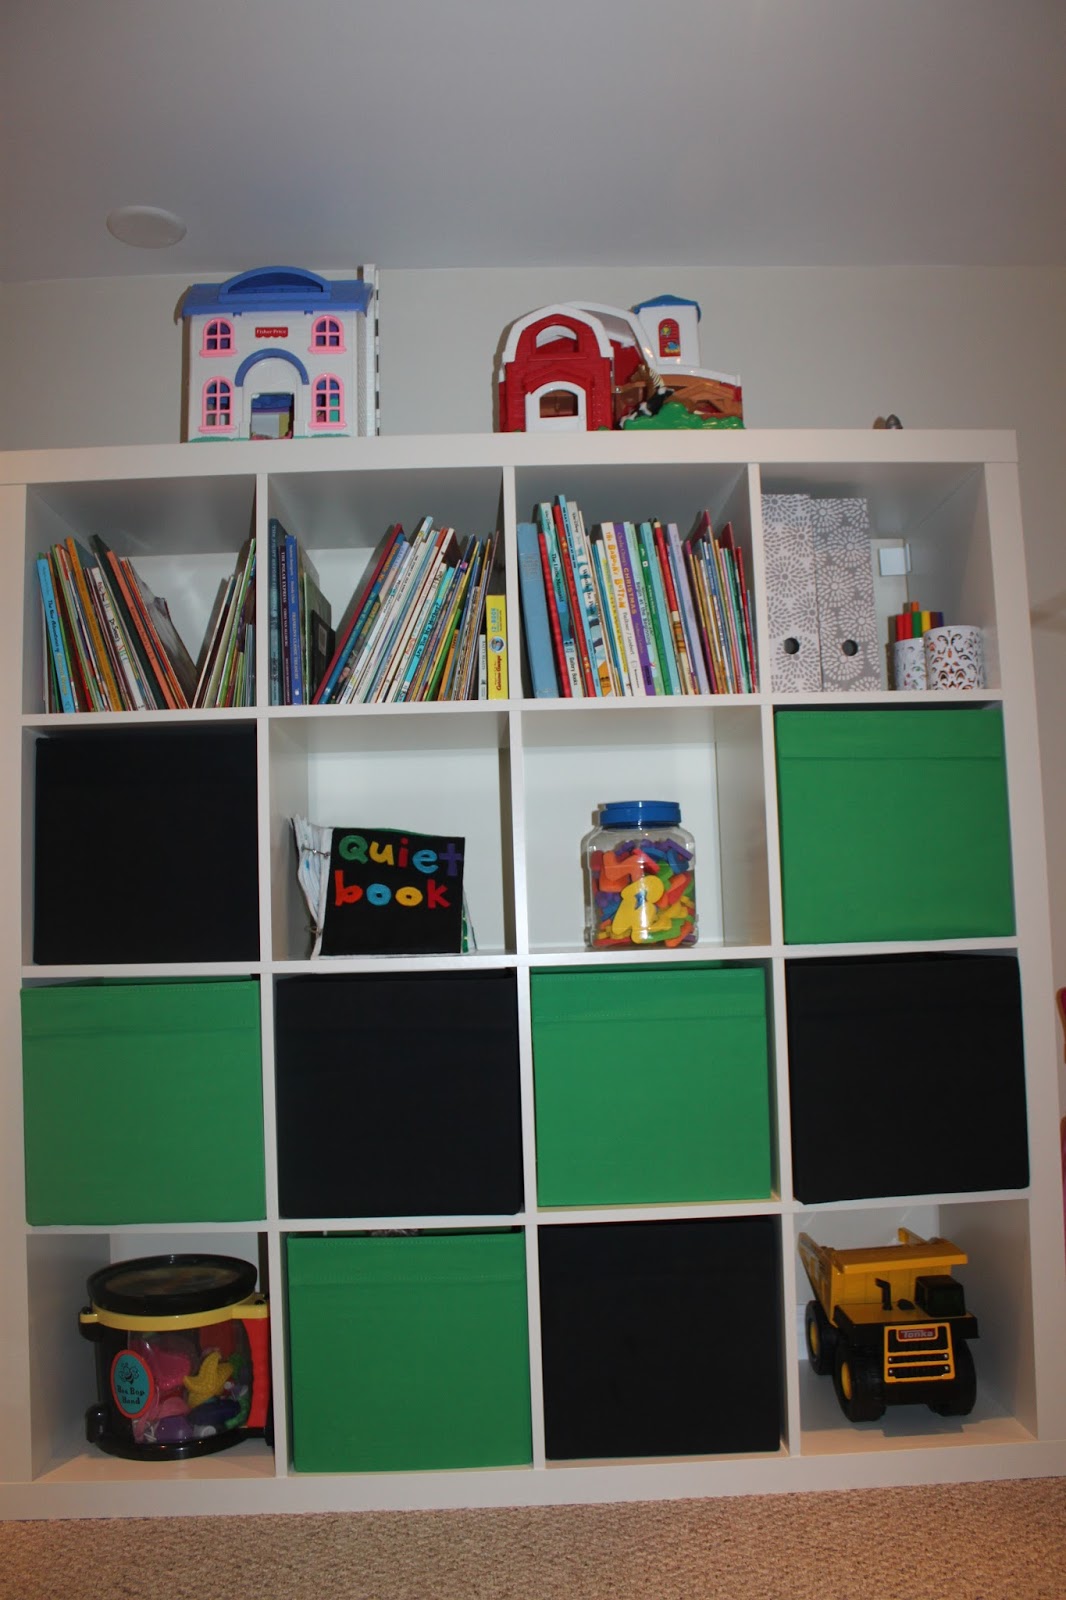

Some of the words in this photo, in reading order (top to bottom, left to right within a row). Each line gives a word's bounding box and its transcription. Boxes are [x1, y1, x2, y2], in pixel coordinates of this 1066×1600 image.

[623, 567, 636, 614] CHRISTMAS
[427, 601, 441, 626] Mother?
[555, 578, 564, 602] Mermaid
[568, 656, 576, 672] Gallery
[613, 578, 627, 608] BOTTOM
[622, 611, 630, 630] Faulkner
[627, 636, 635, 655] Lambert
[634, 581, 642, 597] Begin
[641, 617, 652, 645] Beginning
[419, 635, 427, 646] You
[423, 625, 432, 636] My
[338, 834, 463, 877] Quiet
[334, 870, 451, 909] book
[901, 1329, 933, 1339] Tonka
[122, 1396, 140, 1405] Band
[129, 1387, 145, 1397] Bop
